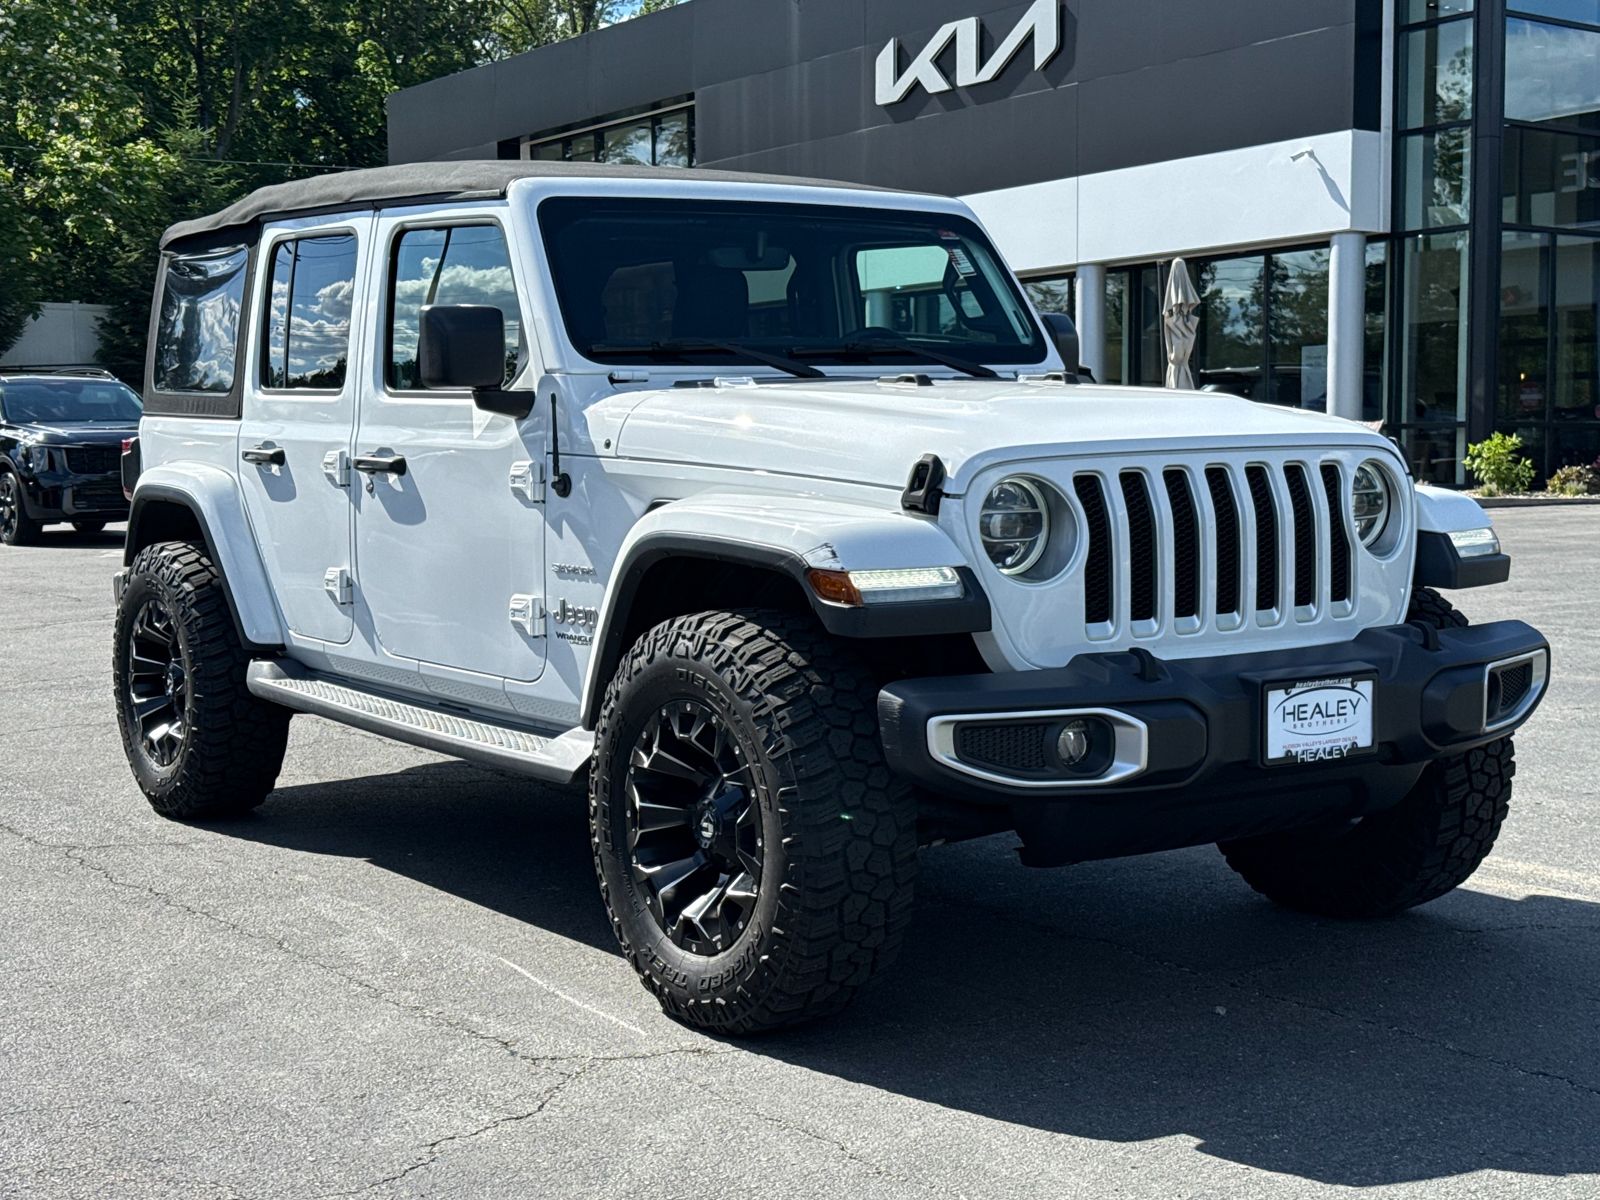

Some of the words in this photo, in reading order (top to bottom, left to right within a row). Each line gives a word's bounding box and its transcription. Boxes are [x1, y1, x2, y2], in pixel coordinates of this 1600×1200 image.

[875, 0, 1060, 105] KIA
[553, 597, 598, 631] Jeep
[555, 631, 593, 641] WRANGLE
[1282, 697, 1361, 723] HEALEY
[1293, 718, 1347, 729] BROTHERS
[1297, 745, 1349, 763] HEALEY
